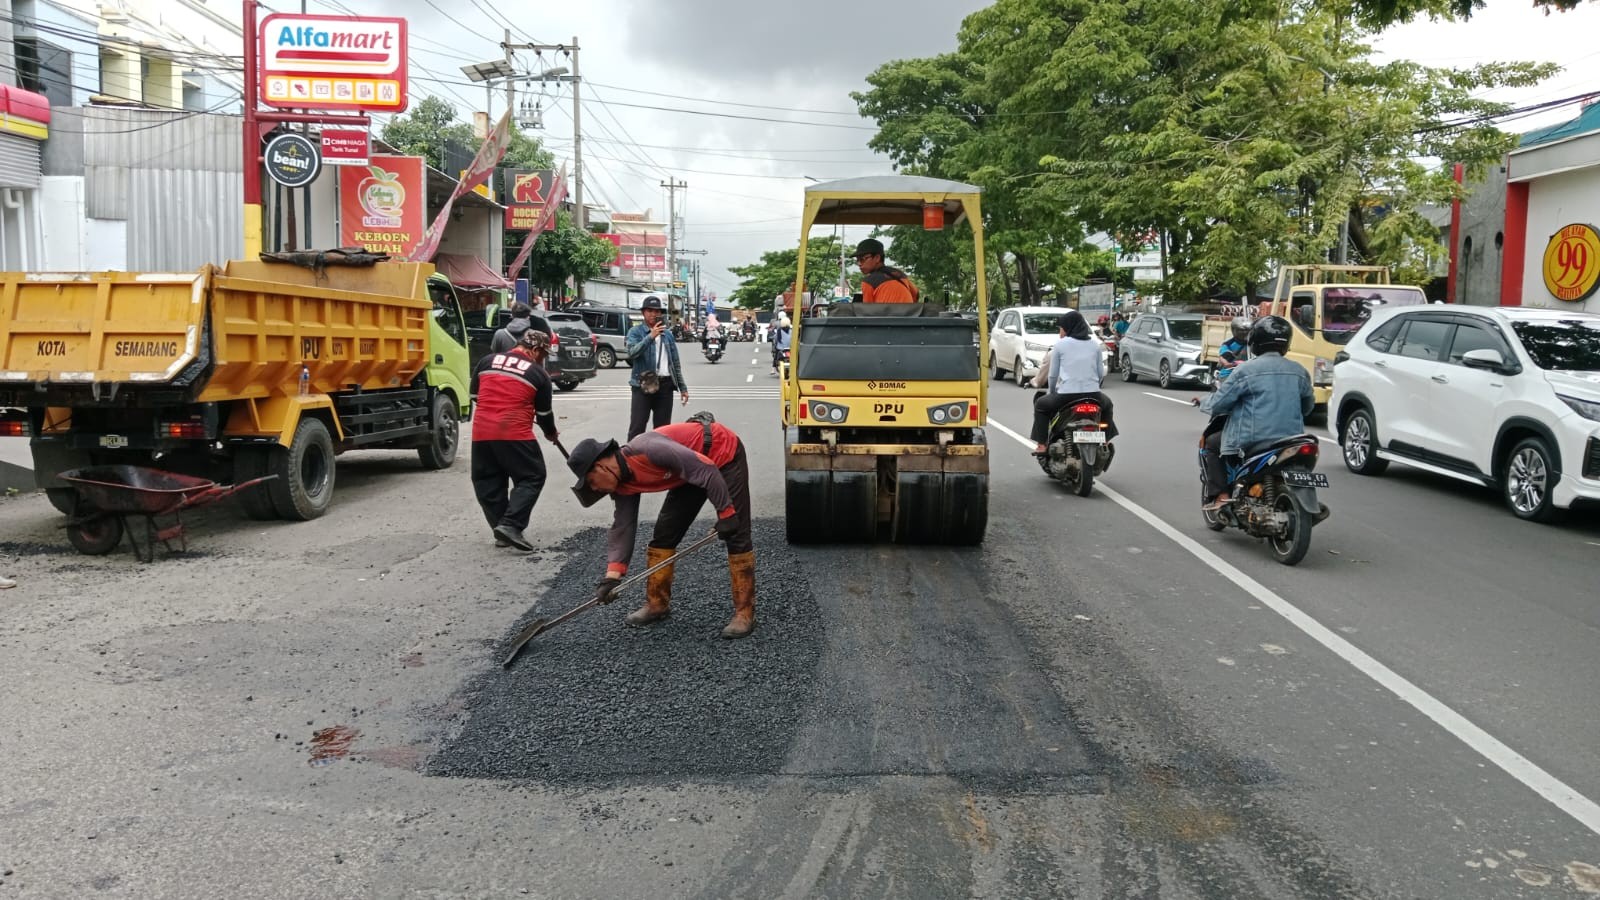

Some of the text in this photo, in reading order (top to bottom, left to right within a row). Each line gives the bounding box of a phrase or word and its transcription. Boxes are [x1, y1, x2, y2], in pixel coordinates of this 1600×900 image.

[278, 26, 393, 49] Alfamart
[273, 150, 310, 170] bean!
[513, 207, 542, 217] ROCKE
[354, 231, 410, 242] KEBOEN
[363, 243, 402, 253] BUAH
[1556, 240, 1587, 286] 99
[37, 340, 177, 357] KOTA SEMARANG
[492, 354, 532, 371] DPU
[874, 403, 904, 414] DPU
